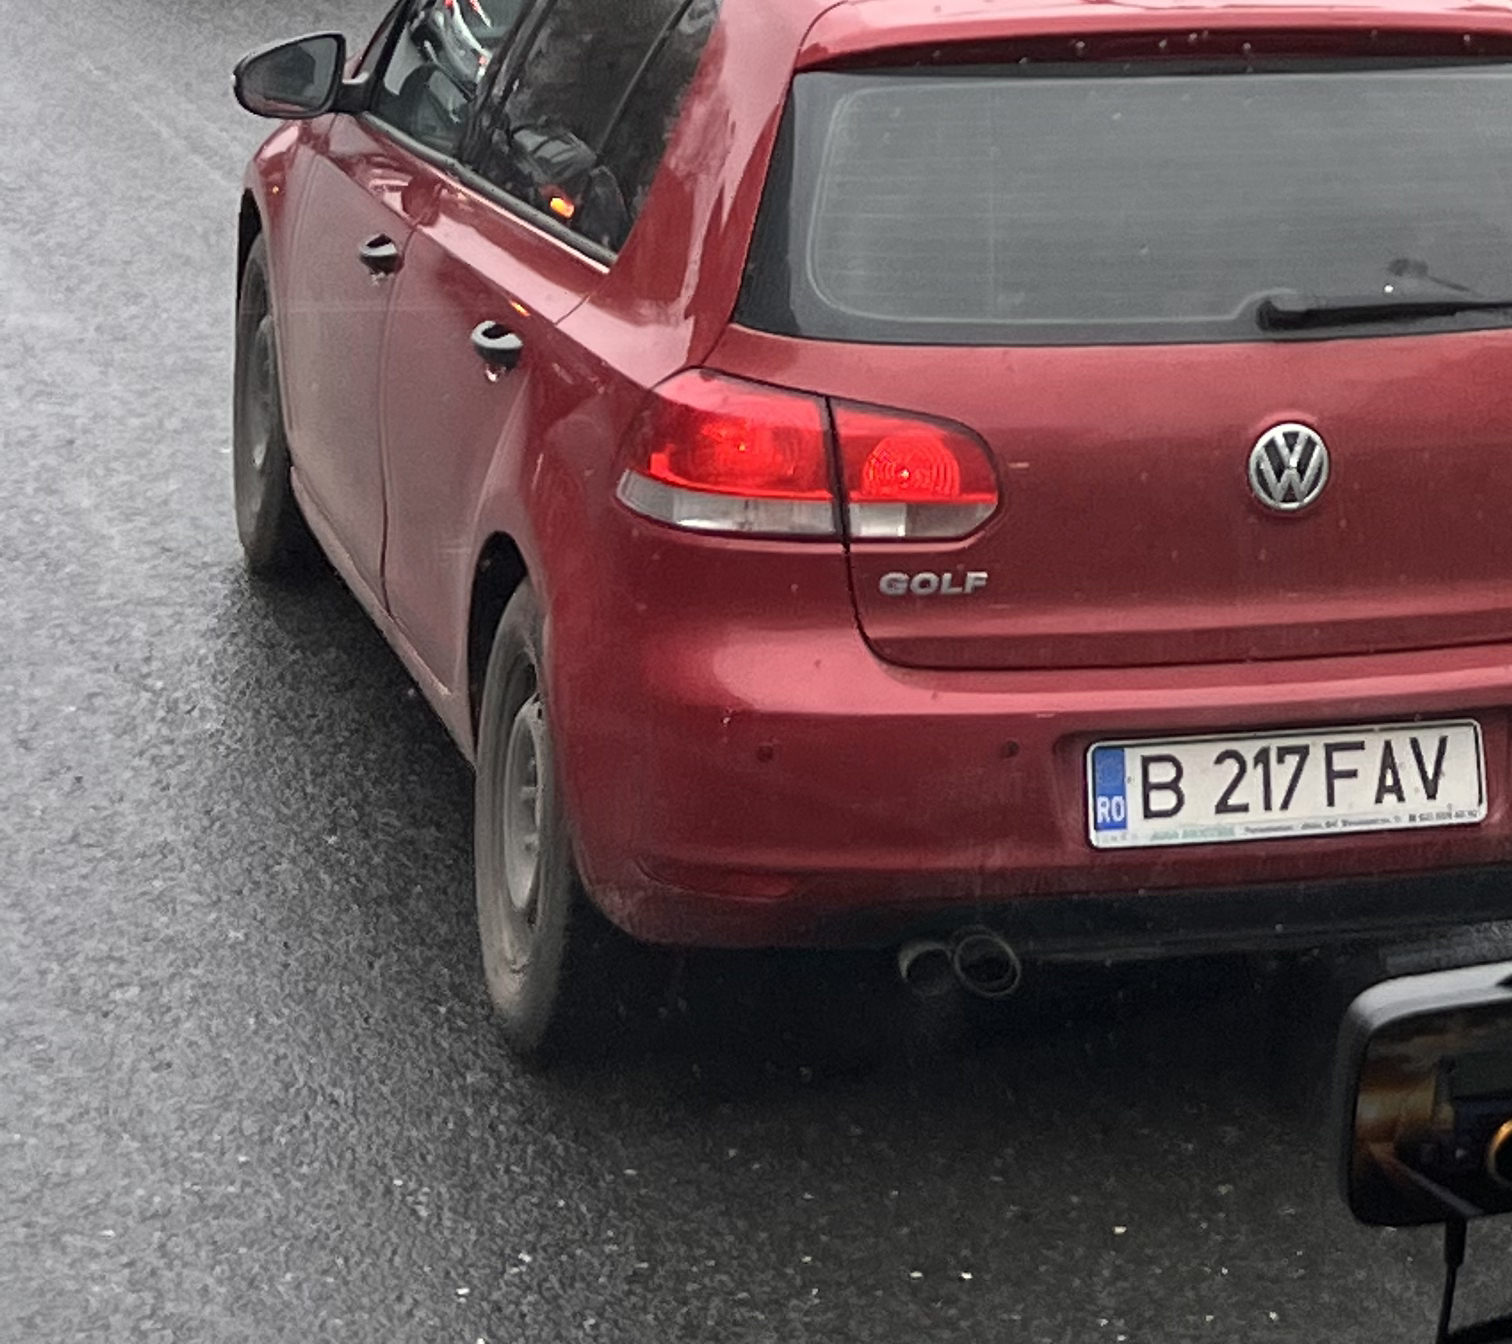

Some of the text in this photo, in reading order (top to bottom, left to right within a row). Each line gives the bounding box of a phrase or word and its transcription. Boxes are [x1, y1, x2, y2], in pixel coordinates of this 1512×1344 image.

[879, 570, 989, 596] GOLF
[1141, 753, 1186, 820] B
[1096, 795, 1126, 824] RO
